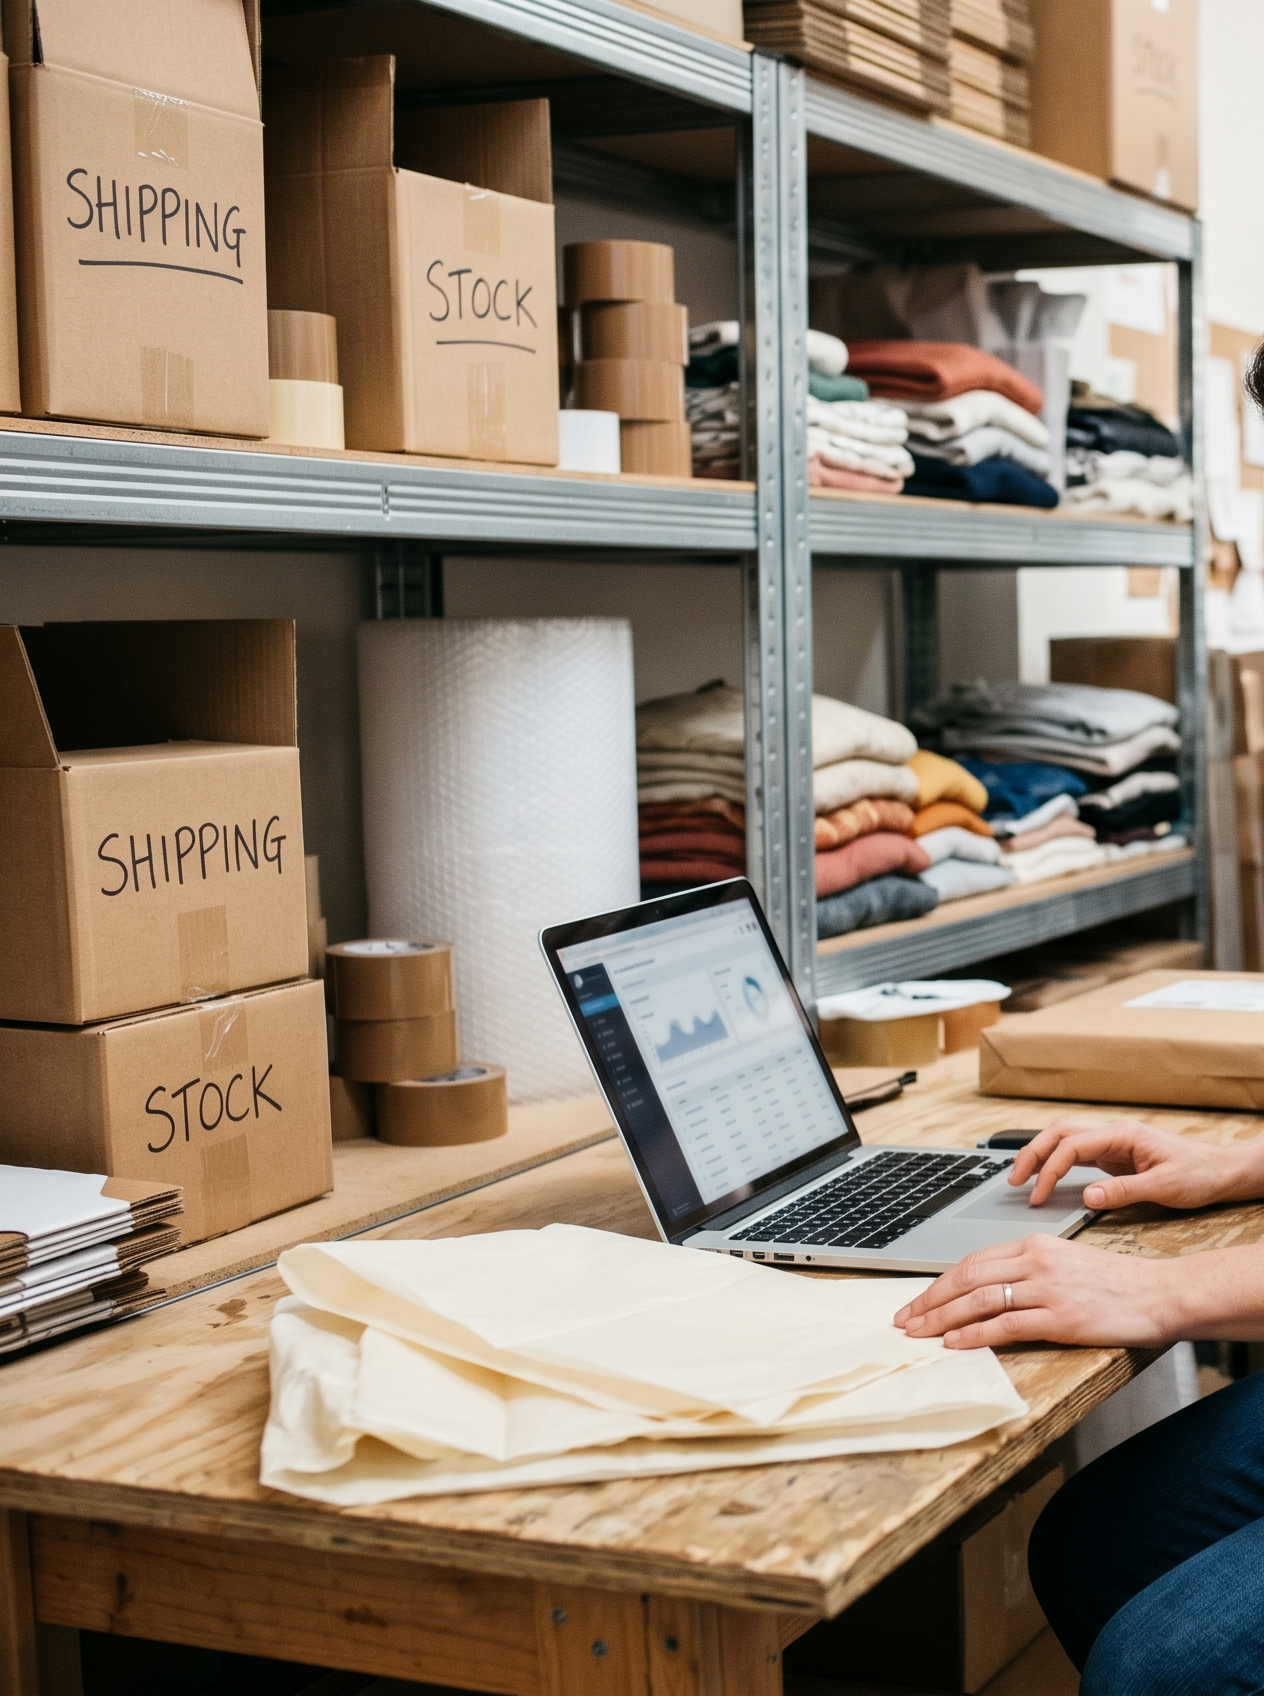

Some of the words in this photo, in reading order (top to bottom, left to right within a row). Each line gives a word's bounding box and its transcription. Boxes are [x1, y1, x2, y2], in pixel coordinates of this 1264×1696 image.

[65, 167, 247, 269] SHIPPING
[426, 260, 537, 328] STOCK
[97, 815, 287, 897] SHIPPING
[145, 1064, 283, 1154] STOCK
